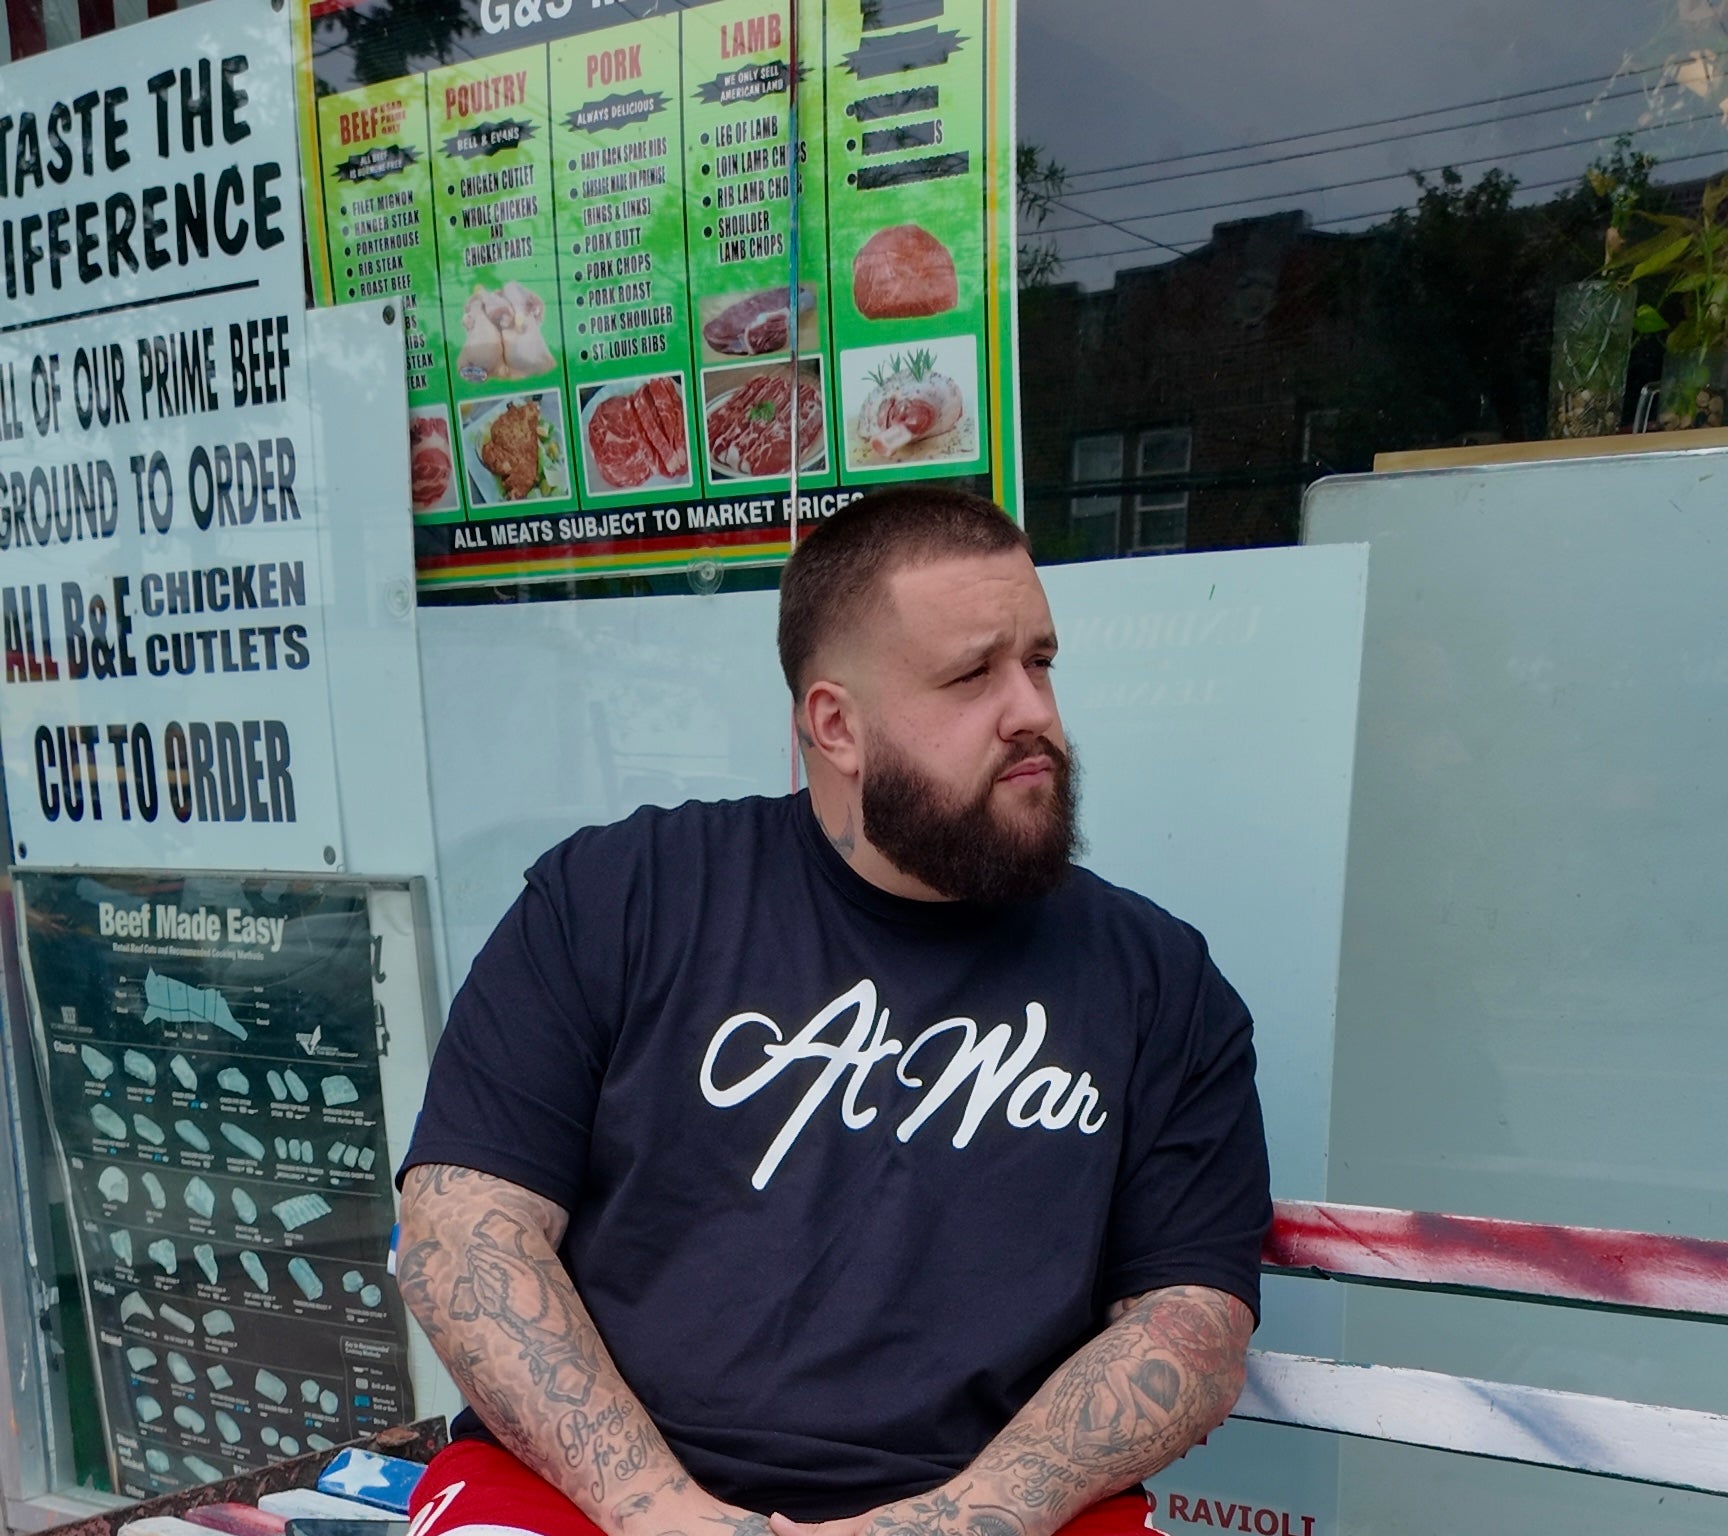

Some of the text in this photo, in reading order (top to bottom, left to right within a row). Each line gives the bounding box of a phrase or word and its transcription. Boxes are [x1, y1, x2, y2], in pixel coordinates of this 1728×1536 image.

[721, 13, 782, 60] LAMB
[587, 44, 642, 88] PORK
[724, 65, 779, 86] WE ONLY SELL
[148, 55, 251, 158] THE
[445, 70, 527, 120] POULTRY
[720, 83, 760, 101] AMERICAN
[340, 107, 378, 145] BEEF
[577, 98, 654, 126] ALWAYS DELICIOUS
[457, 128, 520, 151] BELL & EVANS
[715, 115, 777, 147] LEG OF LAMB
[581, 137, 667, 171] BABY BACK SPARE RIBS
[716, 154, 738, 178] LOIN
[741, 148, 769, 173] LAMB
[461, 165, 534, 198] CHICKEN CUTLET
[582, 177, 609, 198] SAUSAGE
[718, 186, 734, 209] RIB
[738, 180, 765, 205] LAMB
[353, 190, 413, 216] FILET MIGNON
[462, 196, 538, 229] WHOLE CHICKENS
[615, 206, 621, 219] &
[355, 209, 420, 236] HANGER STEAK
[491, 224, 503, 238] AND
[719, 210, 769, 239] SHOULDER
[356, 231, 419, 256] PORTERHOUSE
[465, 236, 532, 267] CHICKEN PARTS
[585, 228, 641, 253] PORK BUTT
[720, 233, 783, 264] LAMB CHOPS
[358, 255, 403, 277] RIB STEAK
[587, 254, 651, 280] PORK CHOPS
[360, 274, 411, 296] ROAST BEEF
[589, 281, 651, 307] PORK ROAST
[590, 306, 673, 334] PORK SHOULDER
[593, 334, 666, 361] ST. LOUIS RIBS
[0, 315, 290, 441] LL OF OUR PRIME BEEF
[0, 437, 302, 550] GROUND TO ORDER
[454, 527, 488, 550] ALL
[490, 519, 554, 547] MEATS
[558, 511, 647, 540] SUBJECT
[652, 508, 681, 533] TO
[687, 499, 775, 530] MARKET
[2, 561, 306, 683] ALL B&E CHICKEN
[146, 624, 310, 676] CUTLETS
[34, 720, 297, 823] CUT TO ORDER
[99, 902, 285, 953] Beef Made Easy
[700, 979, 1107, 1190] At War
[557, 1396, 634, 1468] Pray
[591, 1435, 622, 1503] for
